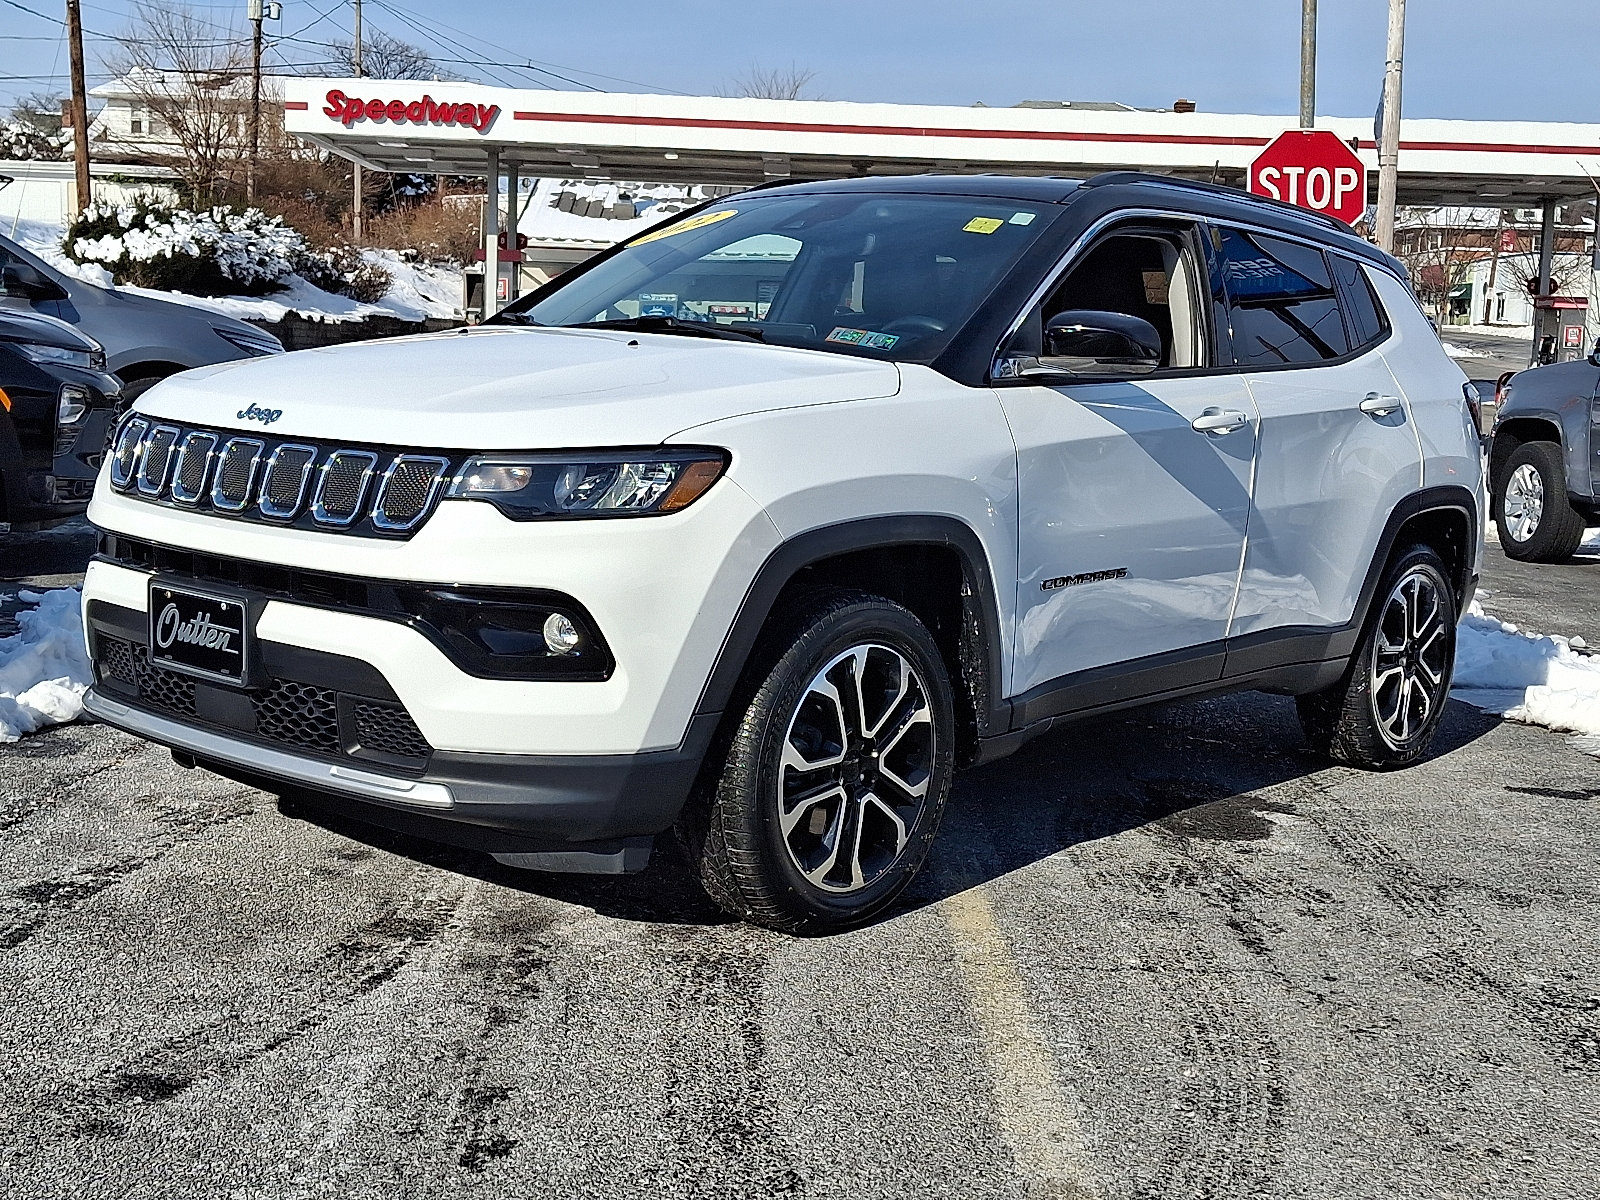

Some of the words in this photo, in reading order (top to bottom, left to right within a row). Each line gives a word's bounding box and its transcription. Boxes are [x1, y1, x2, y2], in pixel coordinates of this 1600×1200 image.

[322, 89, 501, 134] Speedway
[1258, 166, 1360, 210] STOP
[236, 402, 283, 425] Jeep
[1040, 567, 1128, 591] COMPASS
[156, 602, 240, 655] Outten
